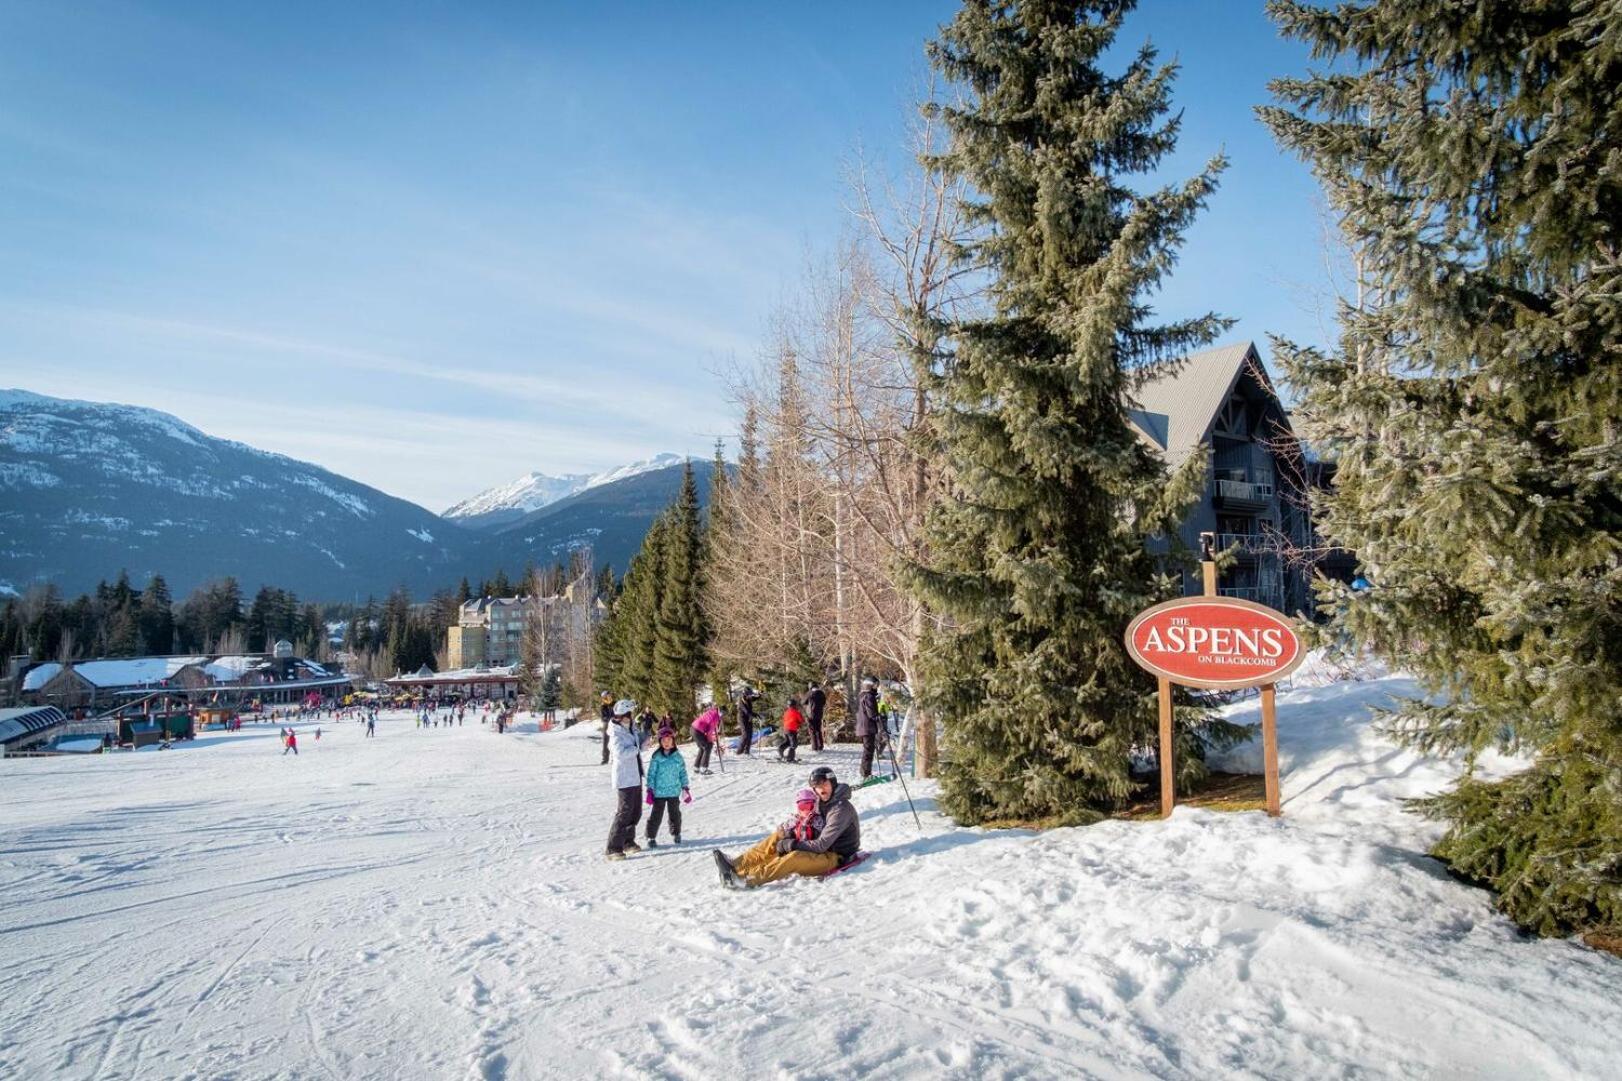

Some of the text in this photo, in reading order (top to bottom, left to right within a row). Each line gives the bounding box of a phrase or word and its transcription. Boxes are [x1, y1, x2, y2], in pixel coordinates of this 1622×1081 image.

[1170, 617, 1190, 626] THE
[1142, 625, 1283, 657] ASPENS
[1198, 655, 1277, 667] ON BLACKCOMB
